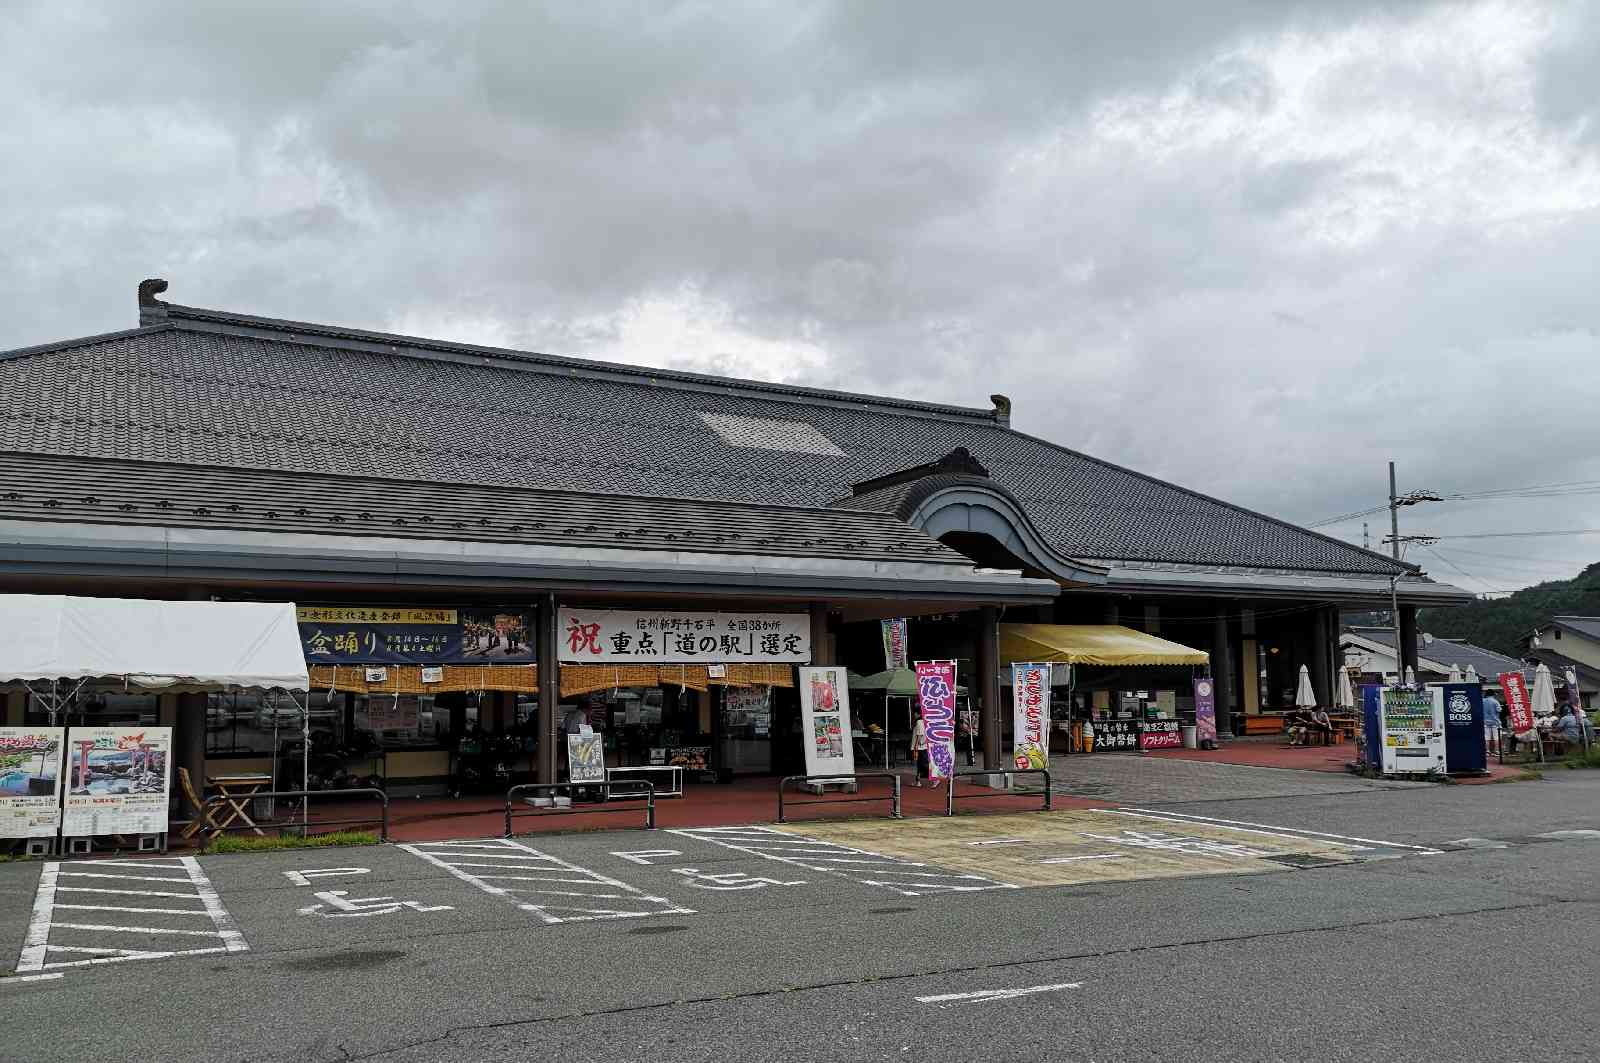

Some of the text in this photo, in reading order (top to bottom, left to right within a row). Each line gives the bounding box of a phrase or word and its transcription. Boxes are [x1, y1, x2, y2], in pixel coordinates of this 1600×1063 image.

[636, 618, 781, 631] 信州新野千石平 全国38か所
[307, 630, 377, 656] 盆踊り
[566, 617, 602, 655] 祝
[610, 632, 803, 656] 重点「道の駅」選定
[1448, 713, 1473, 721] BOSS
[1143, 734, 1182, 746] ソフトクリーム
